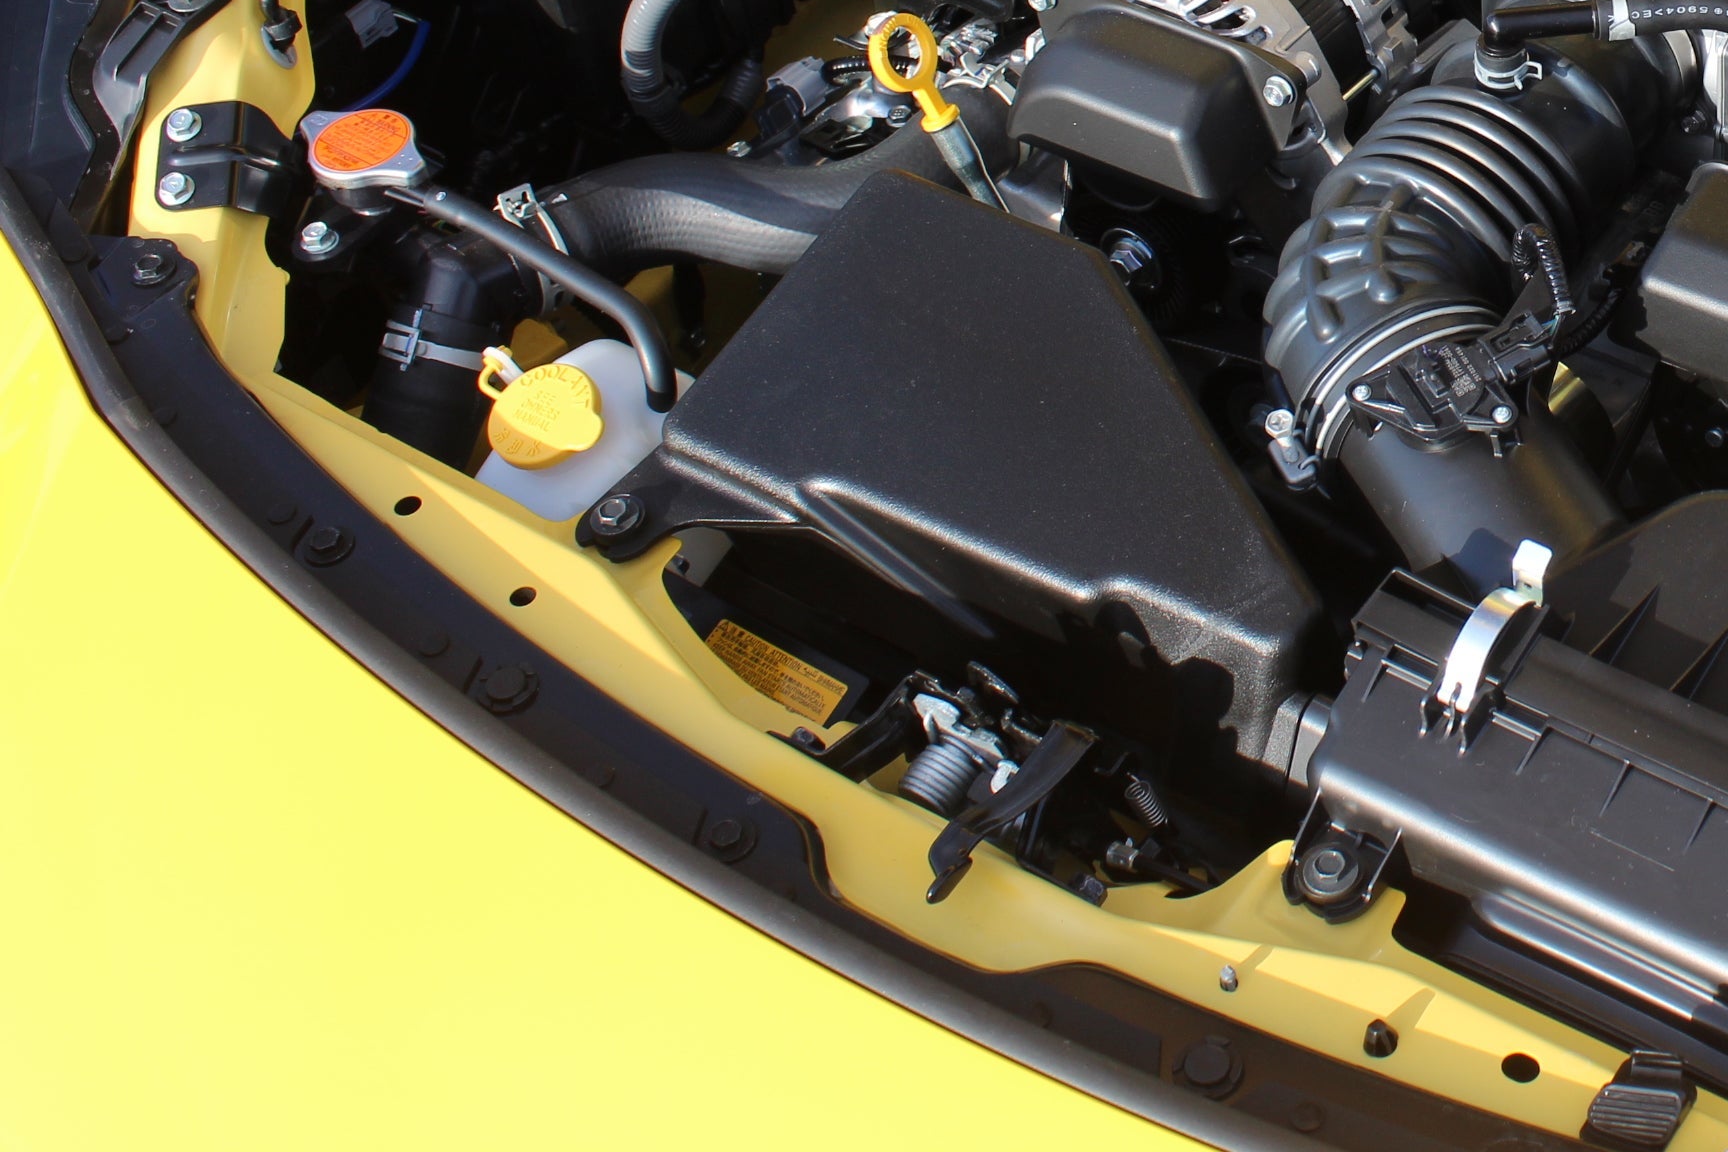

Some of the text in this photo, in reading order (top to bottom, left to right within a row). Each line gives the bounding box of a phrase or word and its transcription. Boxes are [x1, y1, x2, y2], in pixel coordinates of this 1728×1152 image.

[519, 365, 591, 409] COOLANT
[744, 633, 770, 654] CAUTION
[771, 649, 803, 670] ATTENTION
